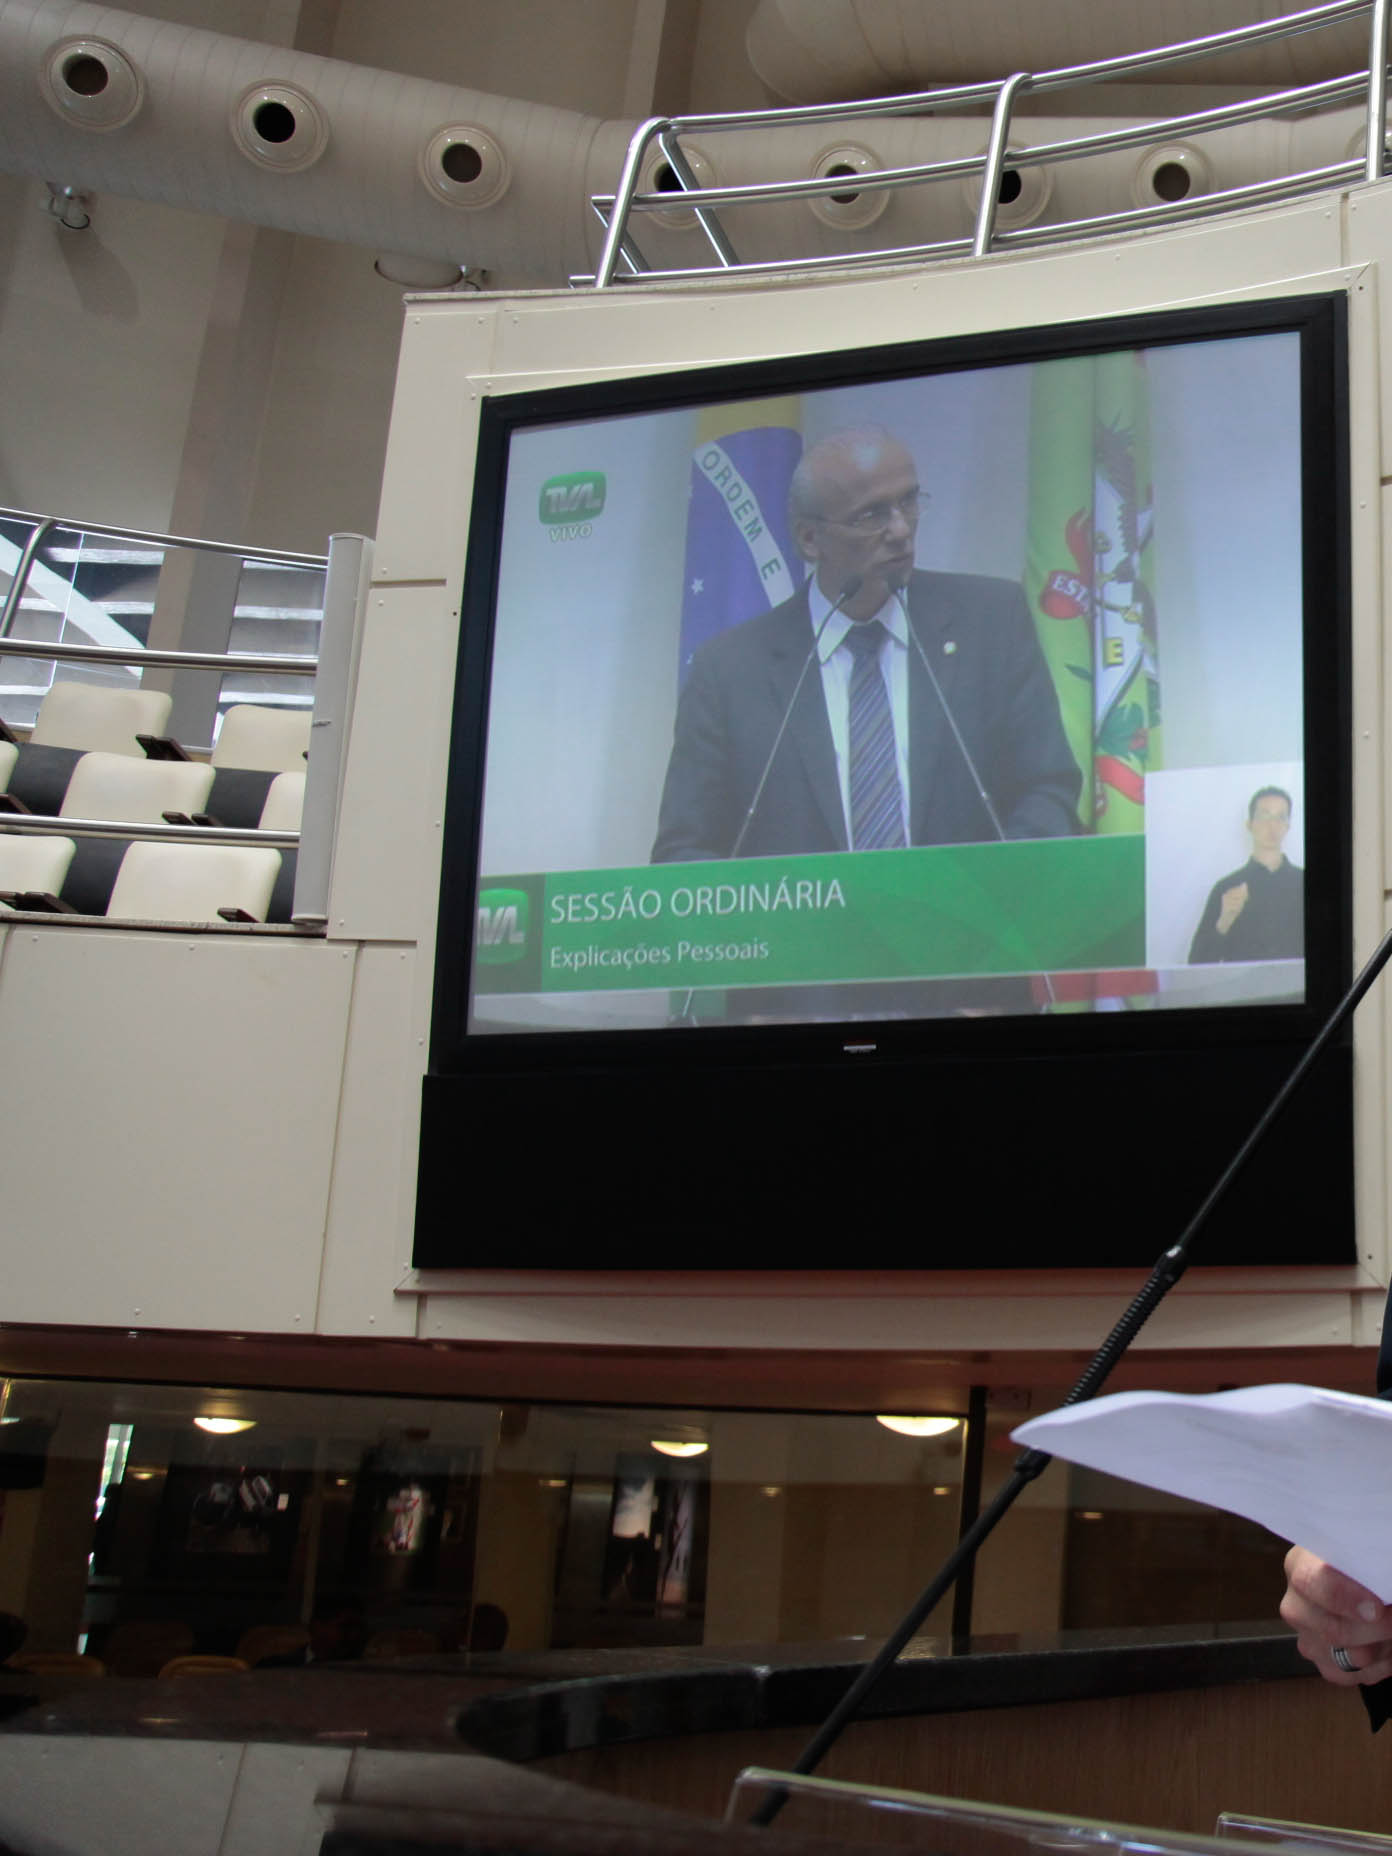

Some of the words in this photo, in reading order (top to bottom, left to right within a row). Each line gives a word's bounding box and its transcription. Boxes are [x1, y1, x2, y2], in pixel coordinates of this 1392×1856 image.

[549, 523, 592, 542] VIVO
[702, 449, 763, 543] ORDEM
[761, 557, 782, 580] E
[1052, 575, 1089, 614] EST
[550, 886, 663, 924] SESSÃO
[670, 875, 846, 917] ORDINÁRIA
[550, 944, 671, 973] Explicações
[677, 937, 769, 963] Pessoais
